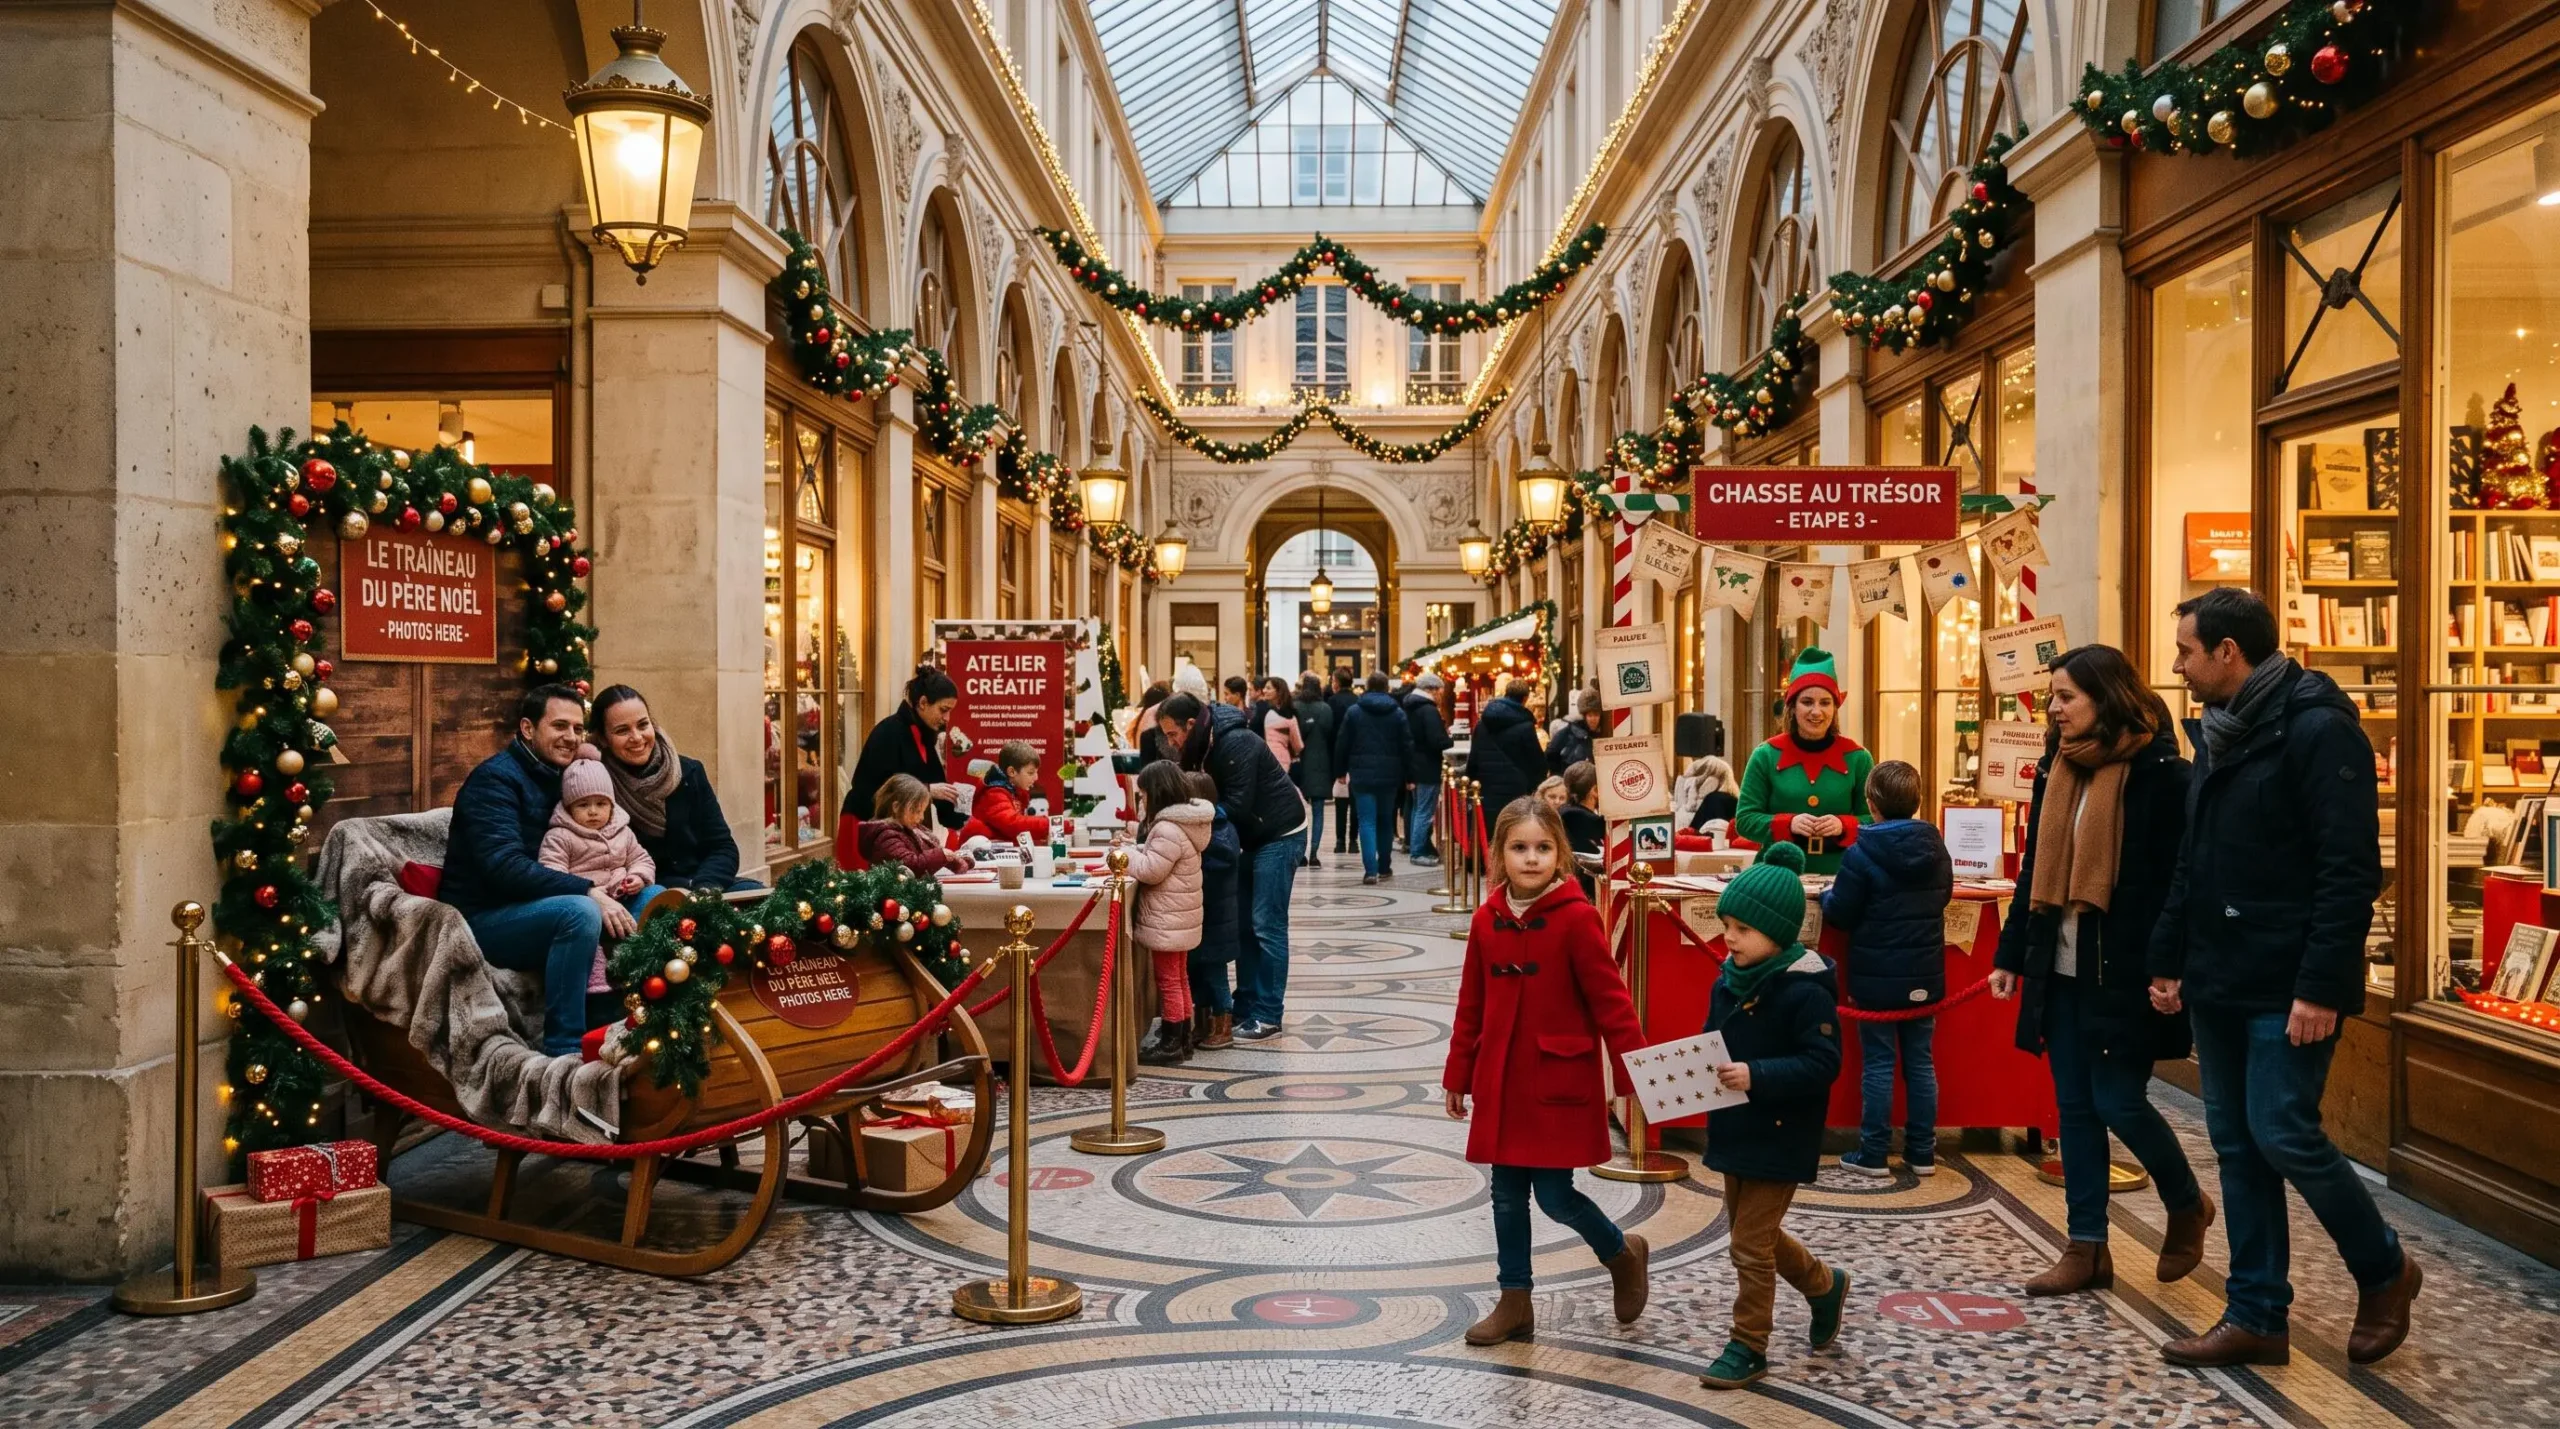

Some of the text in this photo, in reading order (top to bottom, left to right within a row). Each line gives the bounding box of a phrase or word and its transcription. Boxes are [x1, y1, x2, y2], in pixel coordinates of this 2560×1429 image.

[1709, 477, 1941, 504] CHASSE AU TRÉSOR
[1789, 511, 1850, 528] ETAPE
[1854, 511, 1865, 528] 3
[367, 539, 476, 579] LE TRAÎNEAU
[362, 574, 482, 616] DU PÈRE NOËL
[388, 620, 433, 641] PHOTOS
[435, 624, 463, 642] HERE
[966, 655, 1047, 672] ATELIER
[966, 674, 1047, 695] CRÉATIF
[768, 979, 786, 992] DU
[787, 974, 817, 990] PÈRE
[778, 986, 852, 1008] PHOTOS HERE
